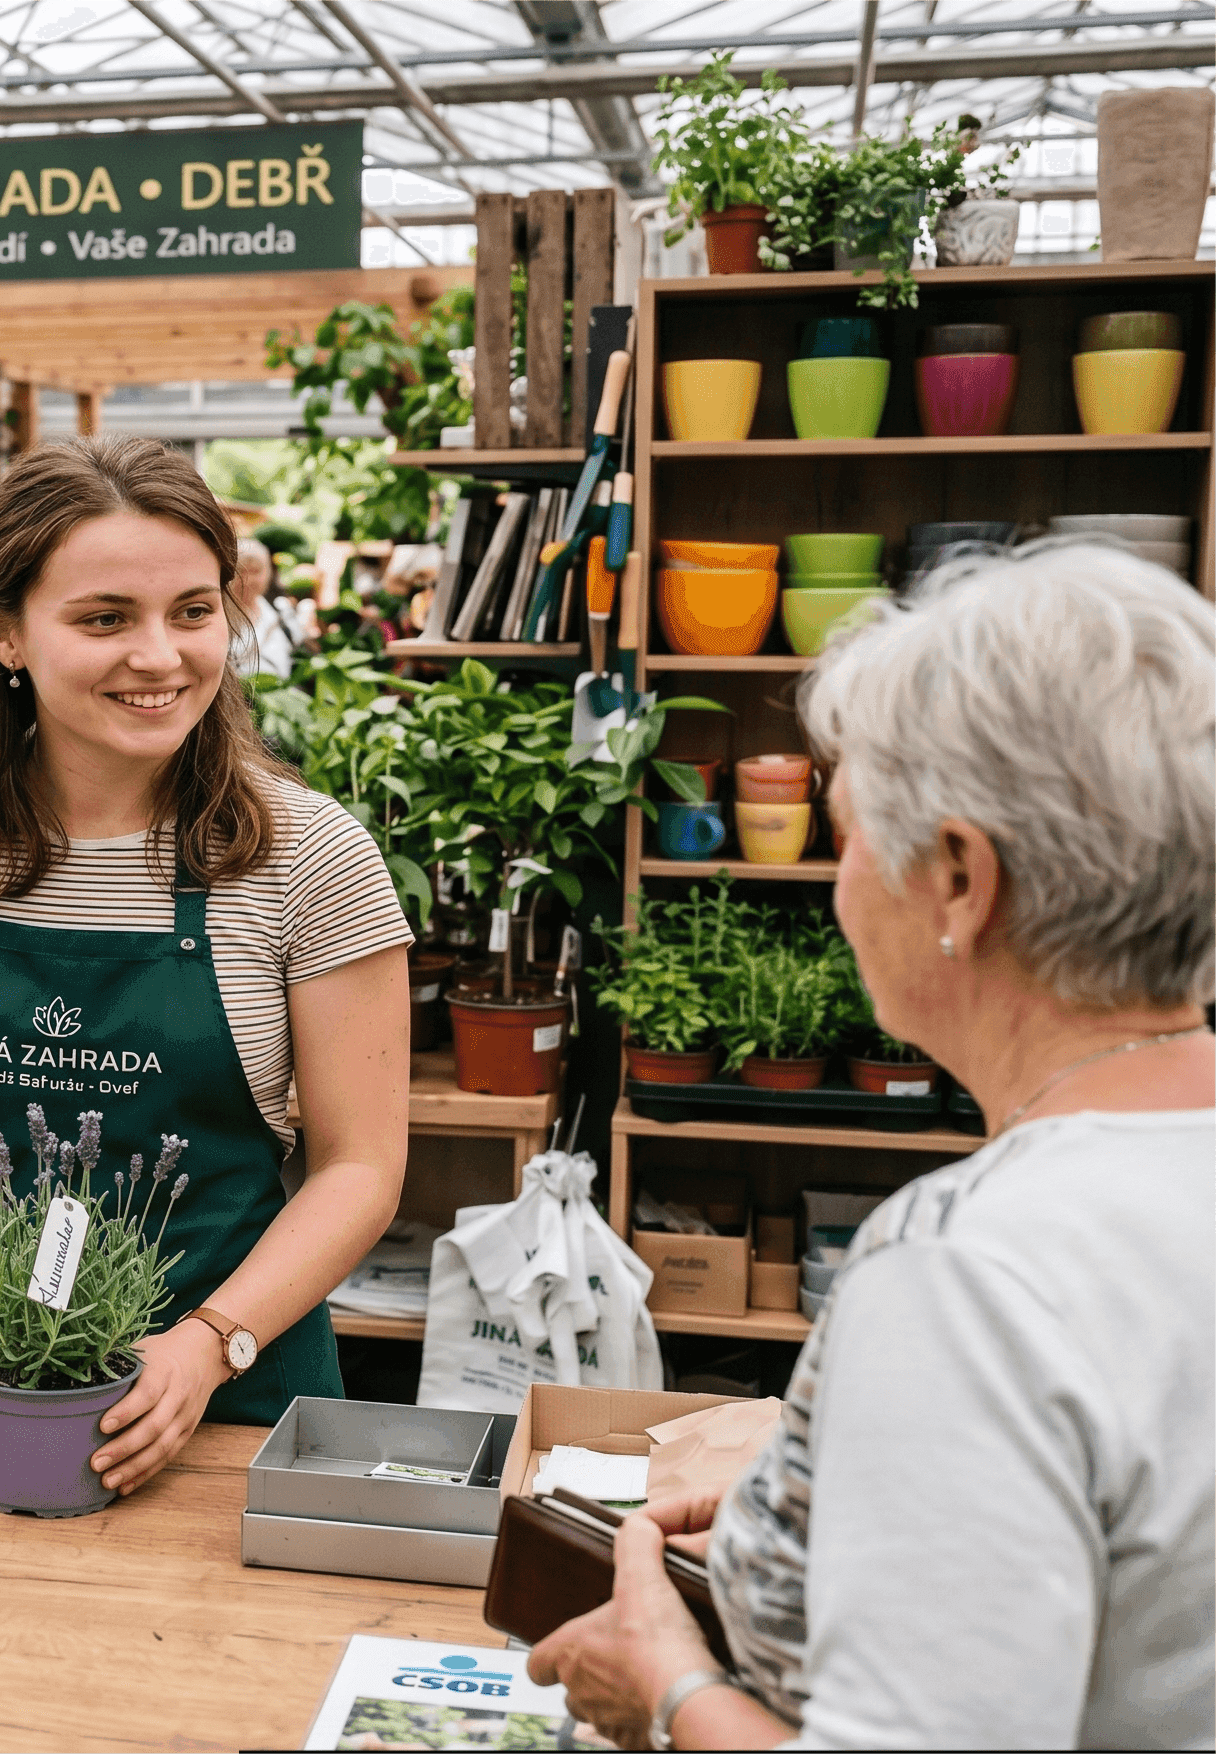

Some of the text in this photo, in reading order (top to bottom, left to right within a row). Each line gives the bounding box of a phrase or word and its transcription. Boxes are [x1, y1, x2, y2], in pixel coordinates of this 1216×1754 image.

[181, 142, 335, 211] DEBŘ
[67, 228, 148, 260] Vaše
[155, 222, 296, 258] Zahrada
[21, 1044, 163, 1074] ZAHRADA
[392, 1674, 511, 1697] CSOB
